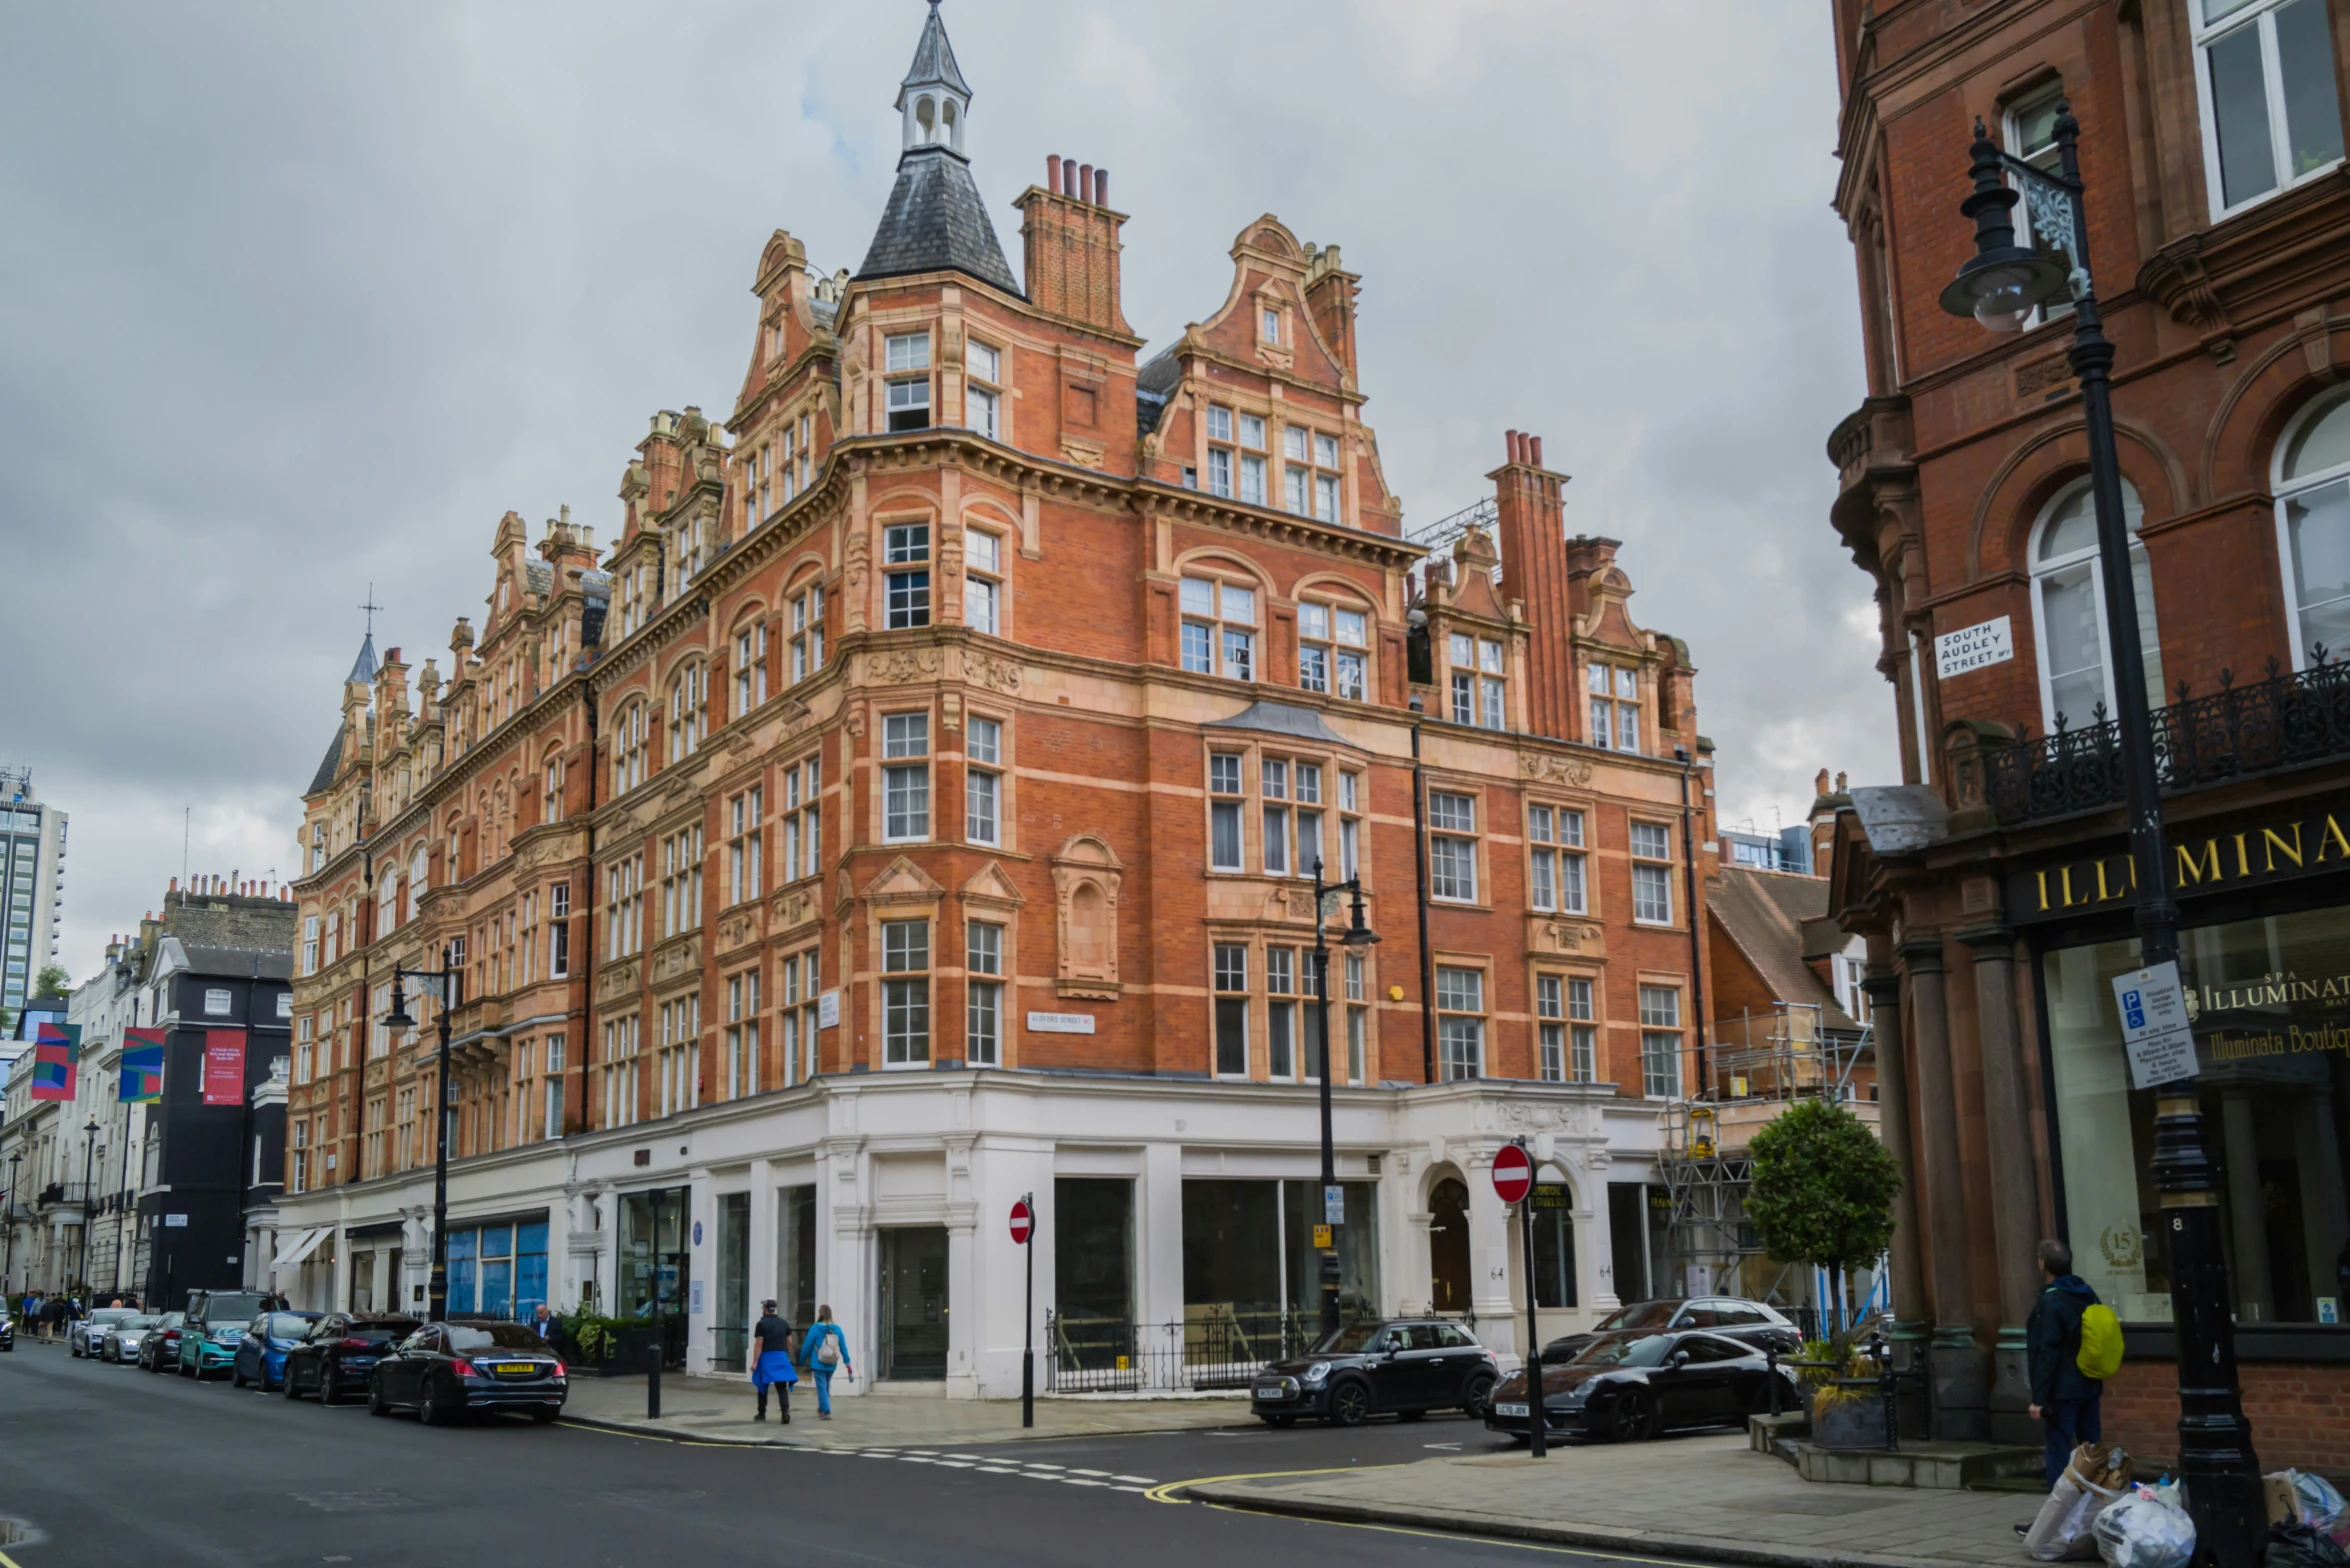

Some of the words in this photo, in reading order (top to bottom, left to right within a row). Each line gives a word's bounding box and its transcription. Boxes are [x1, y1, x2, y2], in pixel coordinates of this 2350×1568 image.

[1944, 624, 1991, 647] SOUTH
[1941, 633, 2001, 660] AUDLEY
[1944, 651, 1993, 674] STREET
[2264, 971, 2296, 984] SPA
[2146, 986, 2175, 998] Disabled
[2151, 994, 2171, 1003] badge
[2151, 1001, 2176, 1010] holders
[1060, 1016, 1081, 1024] STREET
[2162, 1023, 2177, 1031] time
[2209, 1028, 2284, 1061] Illuminata
[2139, 1052, 2170, 1064] Maximum
[2172, 1048, 2185, 1057] stay
[2159, 1058, 2177, 1066] hours
[2173, 1218, 2182, 1231] 8
[2113, 1231, 2131, 1250] 15
[1491, 1267, 1504, 1280] 64
[1600, 1265, 1611, 1278] 64
